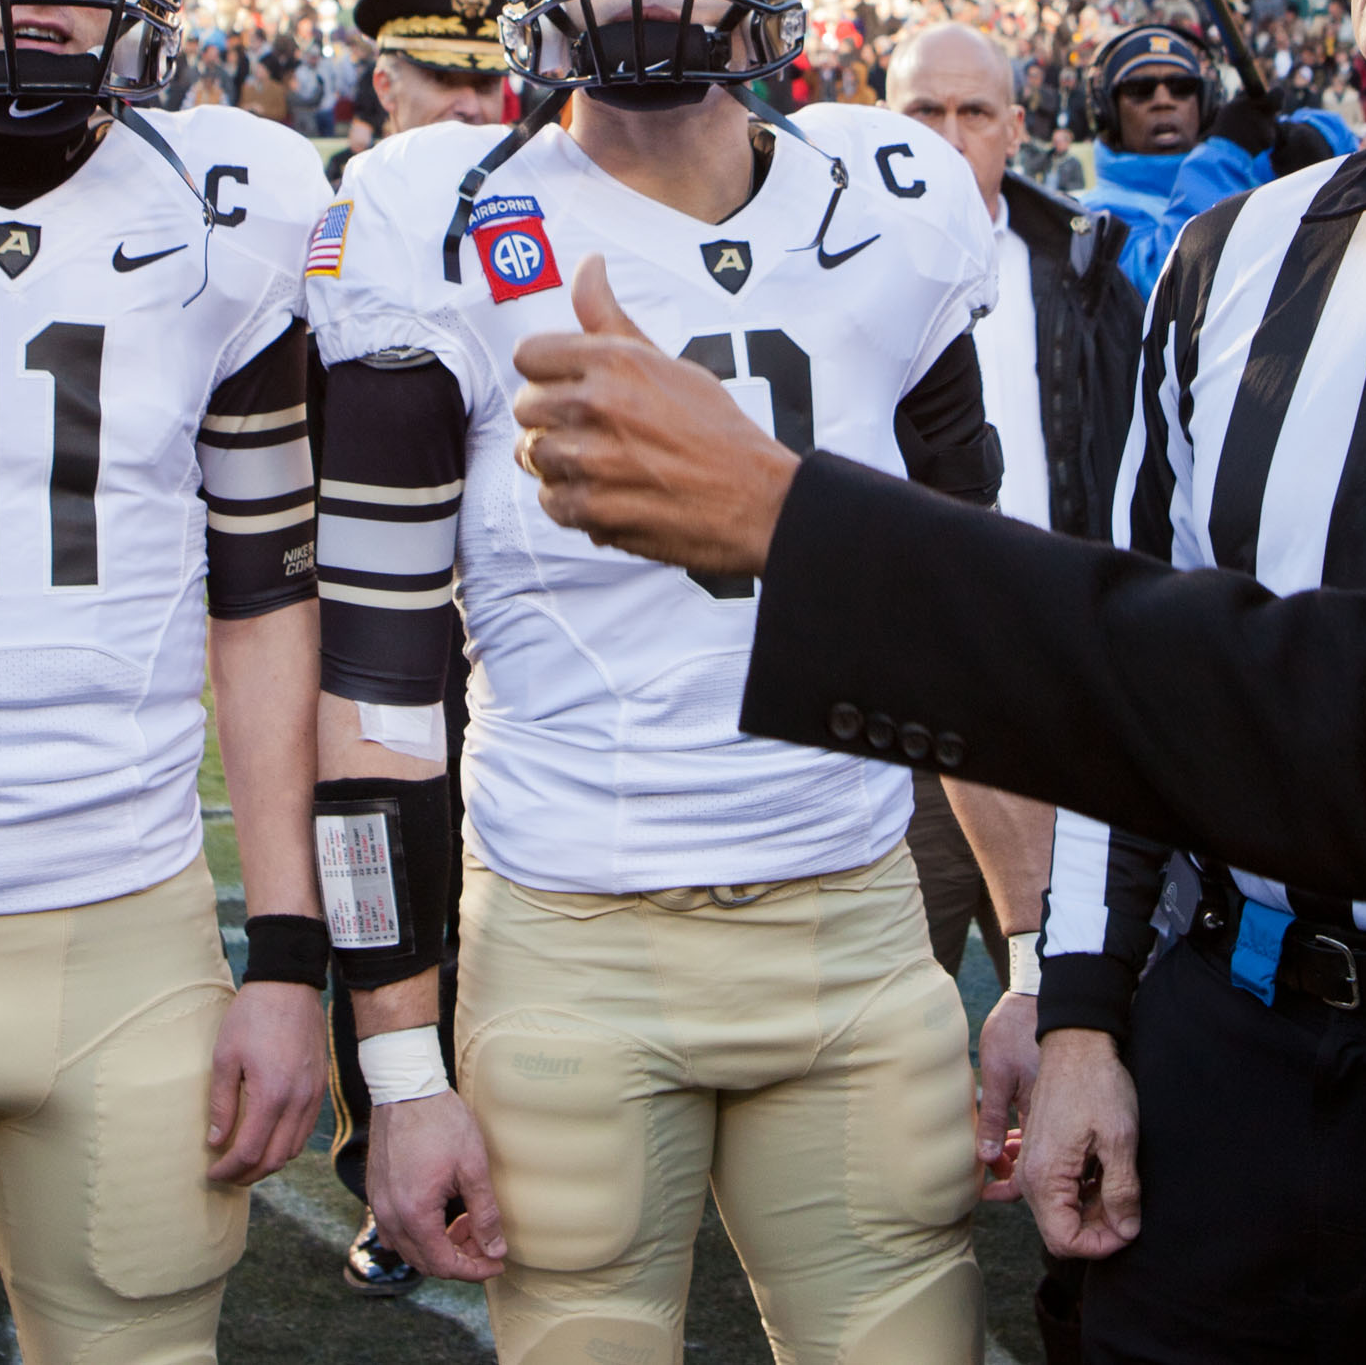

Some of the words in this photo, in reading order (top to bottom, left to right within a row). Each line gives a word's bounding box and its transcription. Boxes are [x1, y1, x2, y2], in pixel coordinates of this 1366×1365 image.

[875, 143, 927, 199] C
[205, 165, 249, 227] C
[469, 199, 535, 226] AIRBORNE
[494, 234, 540, 280] AA
[713, 248, 746, 272] A
